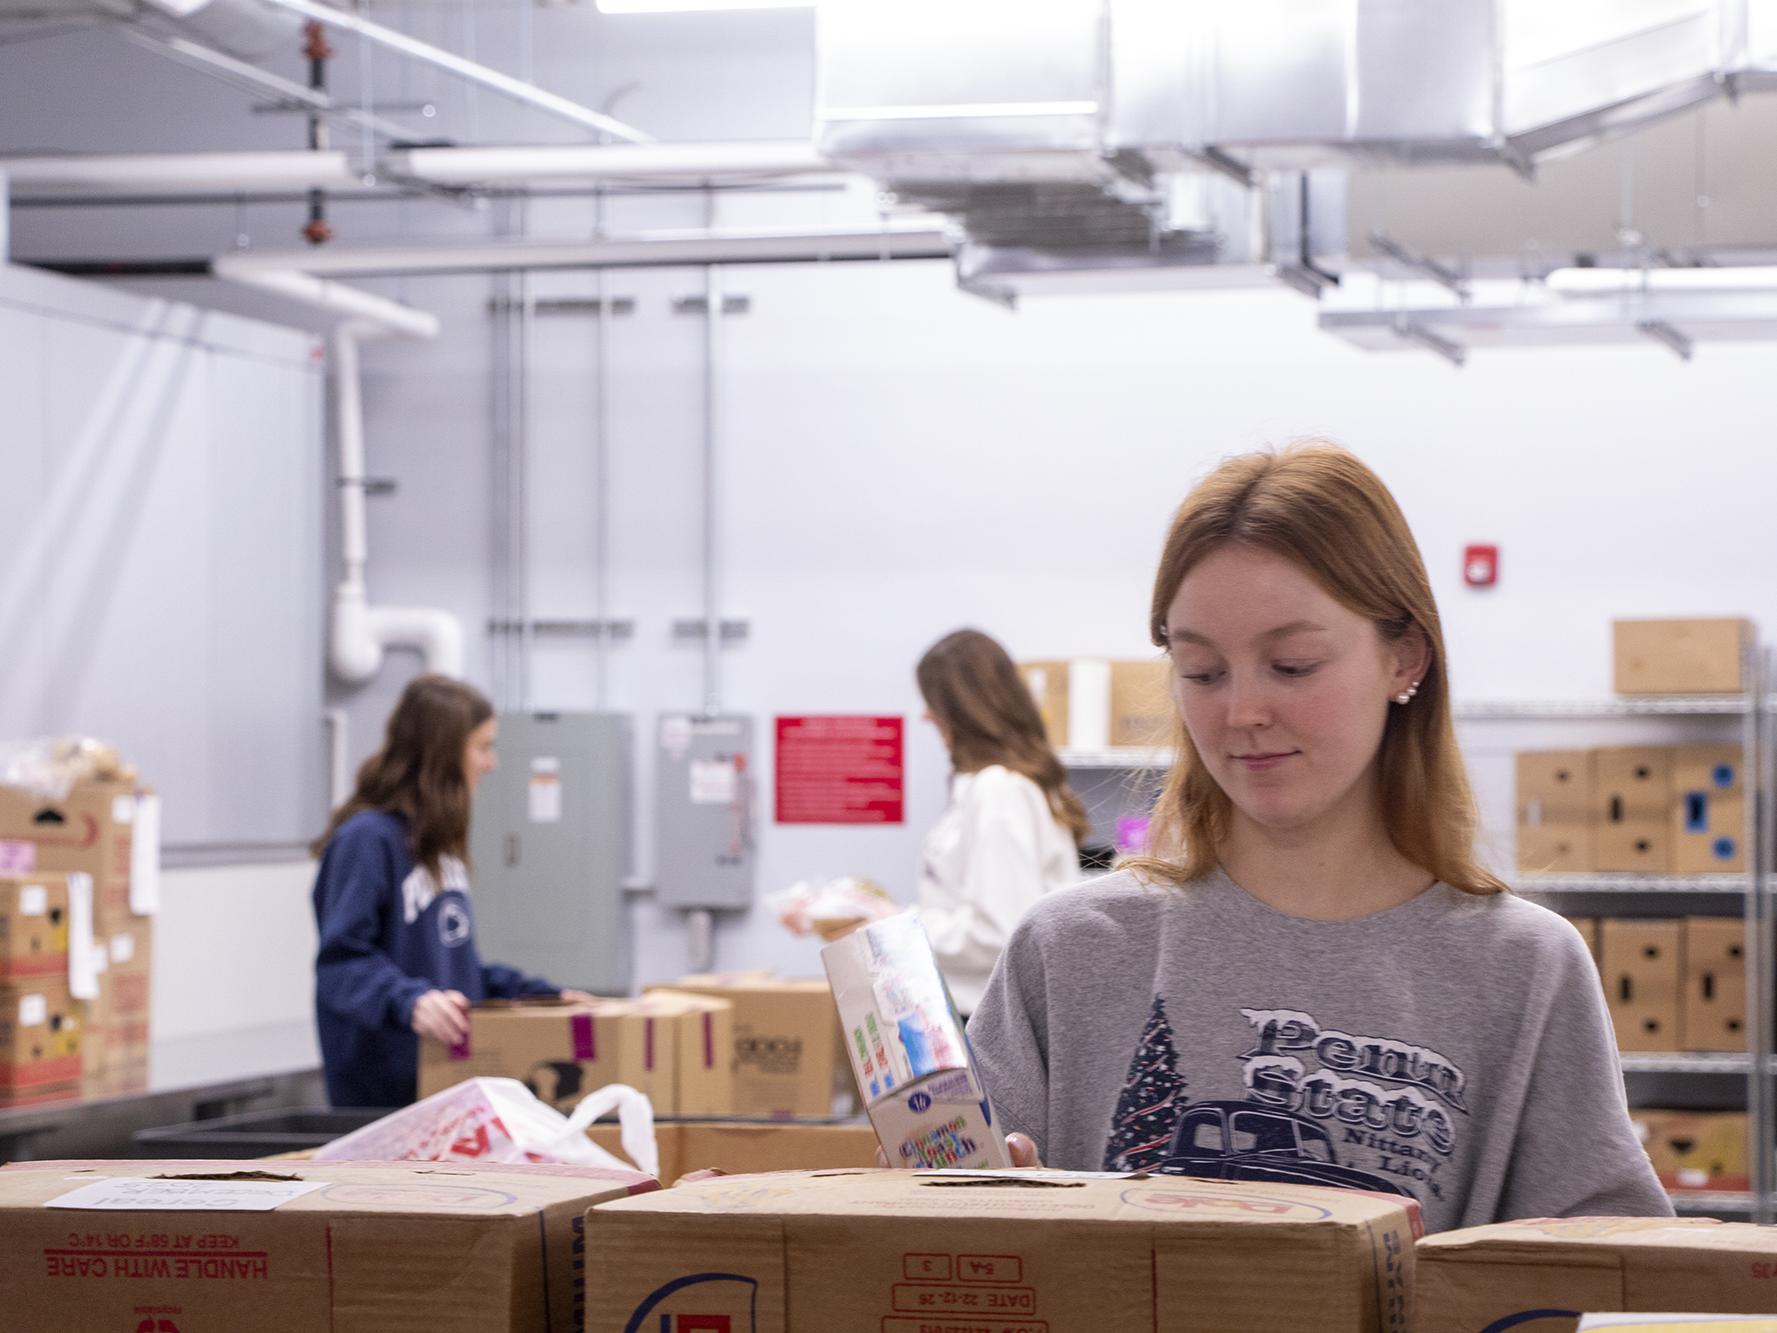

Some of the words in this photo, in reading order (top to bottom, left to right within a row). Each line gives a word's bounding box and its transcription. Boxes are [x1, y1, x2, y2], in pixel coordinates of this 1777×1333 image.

[1237, 1008, 1470, 1115] Penn
[1243, 1055, 1456, 1156] State
[107, 1233, 132, 1247] OR
[173, 1234, 193, 1248] AT
[197, 1234, 240, 1248] KEEP
[47, 1256, 108, 1277] CARE
[114, 1257, 170, 1278] WITH
[175, 1258, 268, 1279] HANDLE
[922, 1260, 932, 1272] 3
[987, 1294, 1031, 1307] DATE
